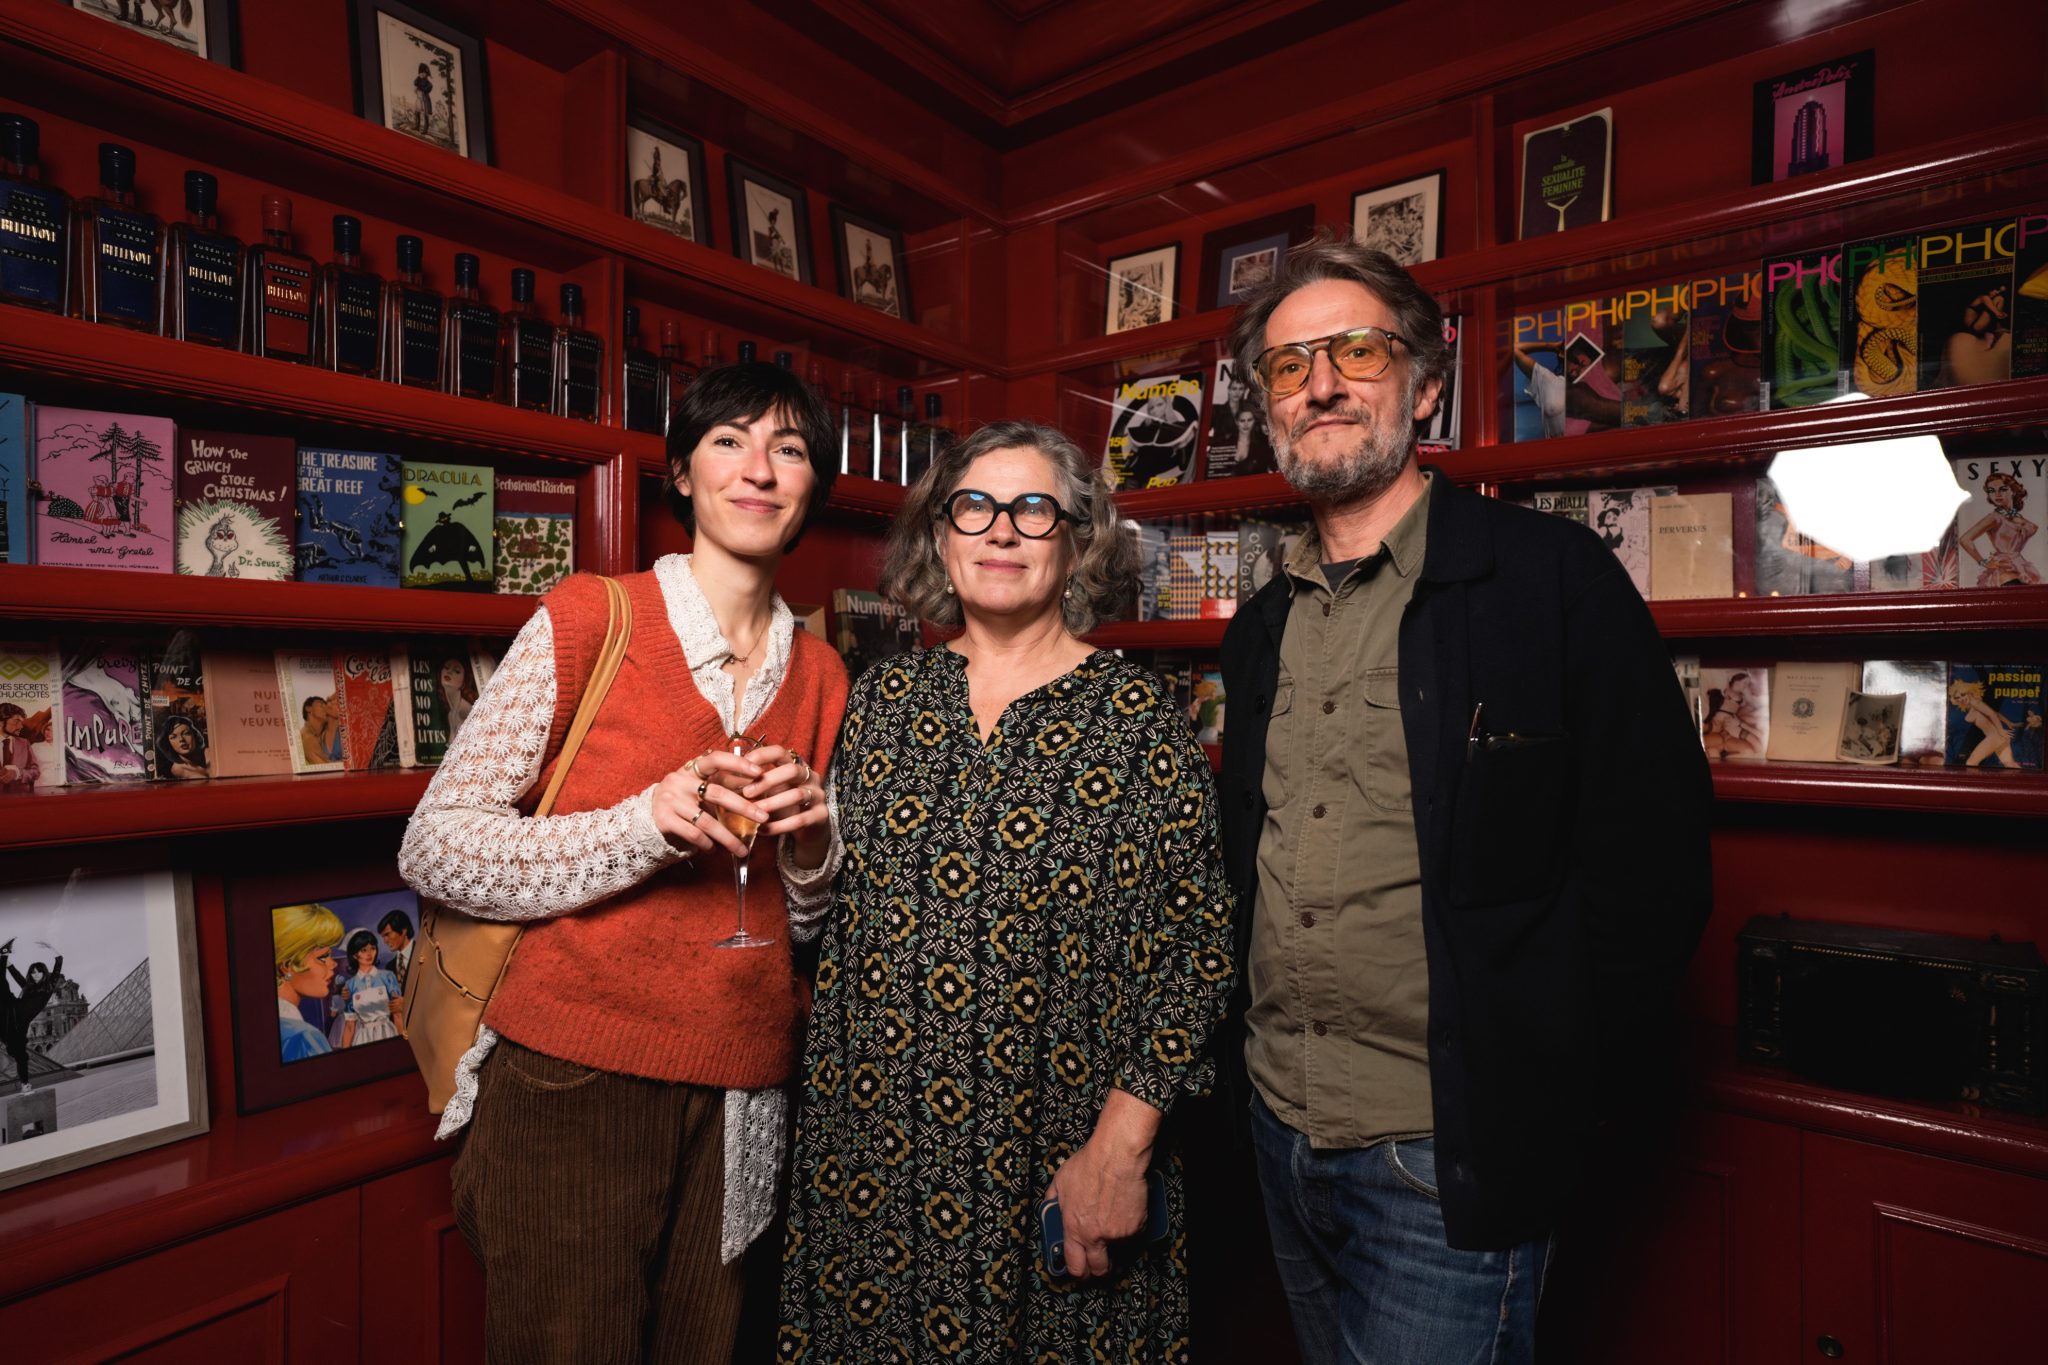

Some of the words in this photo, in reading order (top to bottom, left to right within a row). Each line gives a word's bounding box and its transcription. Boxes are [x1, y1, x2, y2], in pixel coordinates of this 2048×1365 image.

[184, 460, 231, 475] GRINCH
[320, 452, 378, 472] TREASURE
[1967, 458, 2047, 481] SEXY
[306, 466, 325, 478] THE
[404, 468, 482, 486] DRACULA
[220, 475, 255, 487] STOLE
[335, 479, 364, 495] REEF
[255, 558, 280, 568] Seuss
[899, 616, 919, 632] art
[152, 662, 188, 675] POINT
[413, 659, 430, 674] LES
[176, 677, 191, 686] DE
[1989, 669, 2041, 685] passion
[414, 678, 433, 693] COS
[1994, 686, 2041, 699] puppet
[254, 704, 271, 714] DE
[415, 695, 431, 710] MO
[416, 712, 431, 727] PO
[418, 729, 447, 744] LITES
